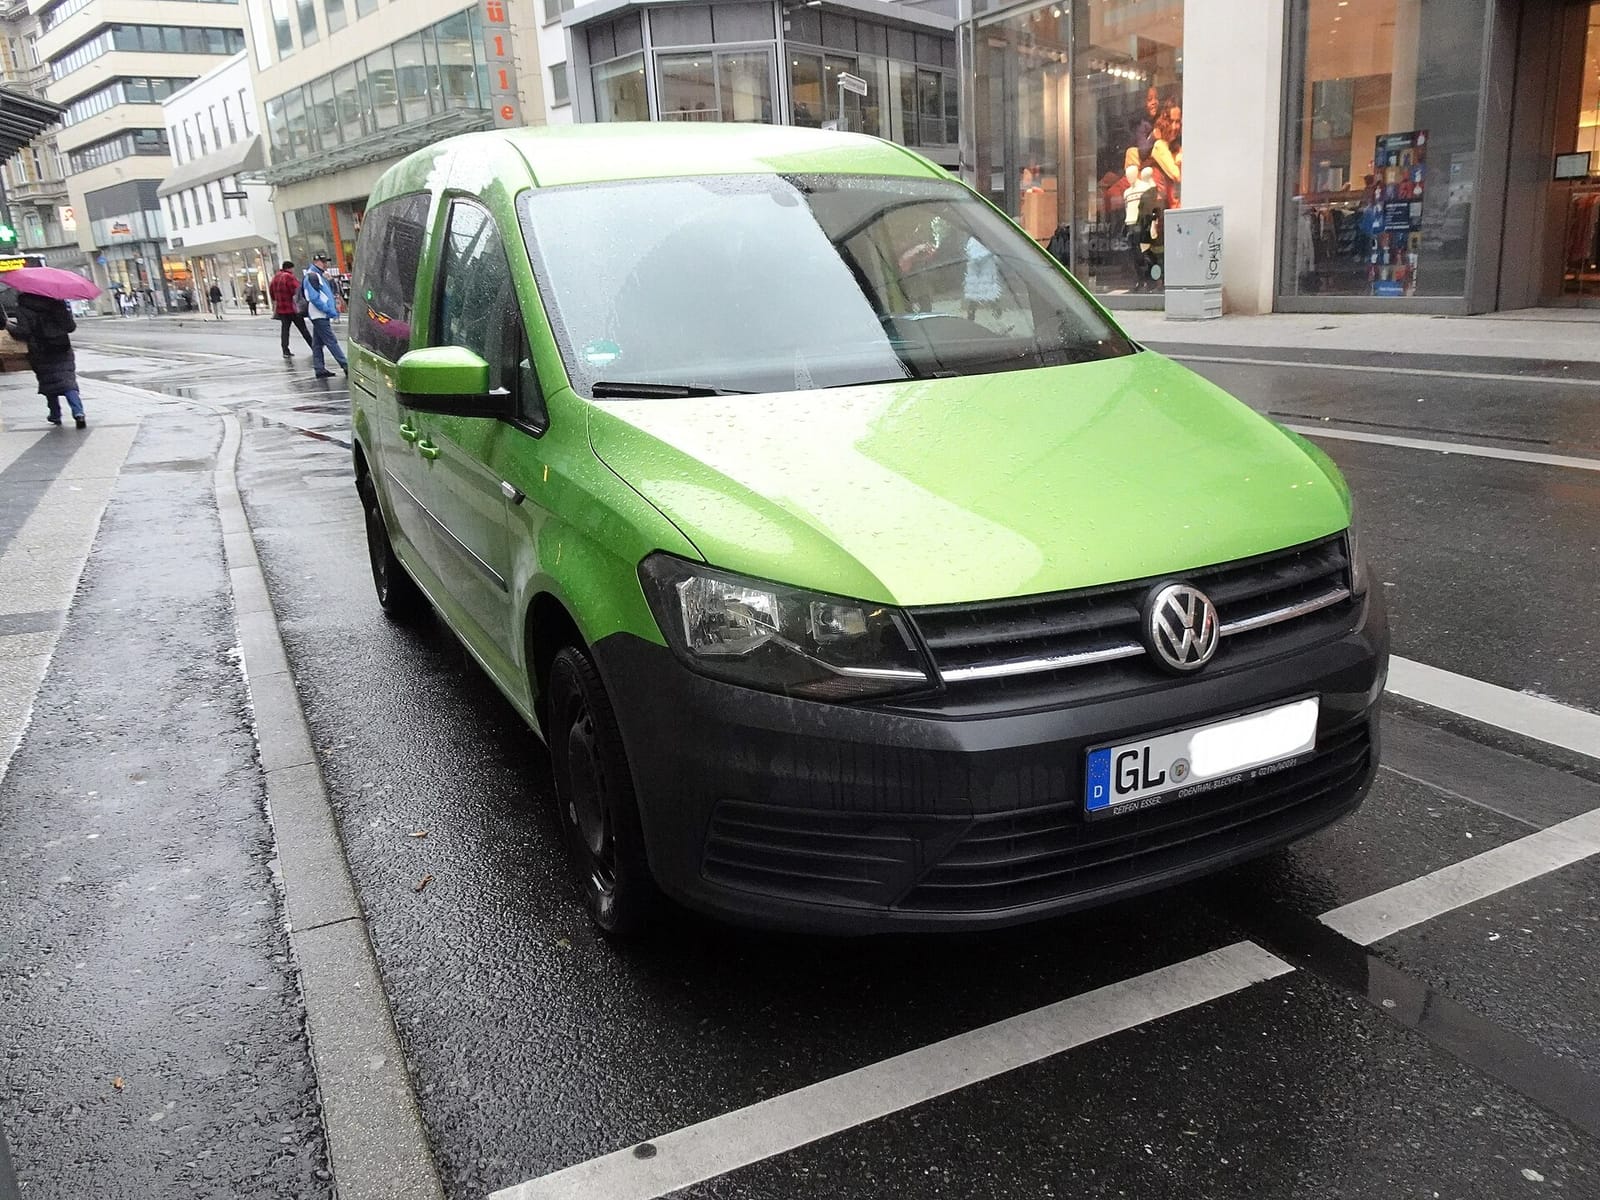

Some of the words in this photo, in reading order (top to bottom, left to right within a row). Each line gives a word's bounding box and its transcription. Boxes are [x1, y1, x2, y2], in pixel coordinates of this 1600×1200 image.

[1115, 746, 1165, 795] GL
[1093, 785, 1103, 799] D
[1113, 801, 1139, 816] REIFEN
[1140, 795, 1162, 809] ESSER
